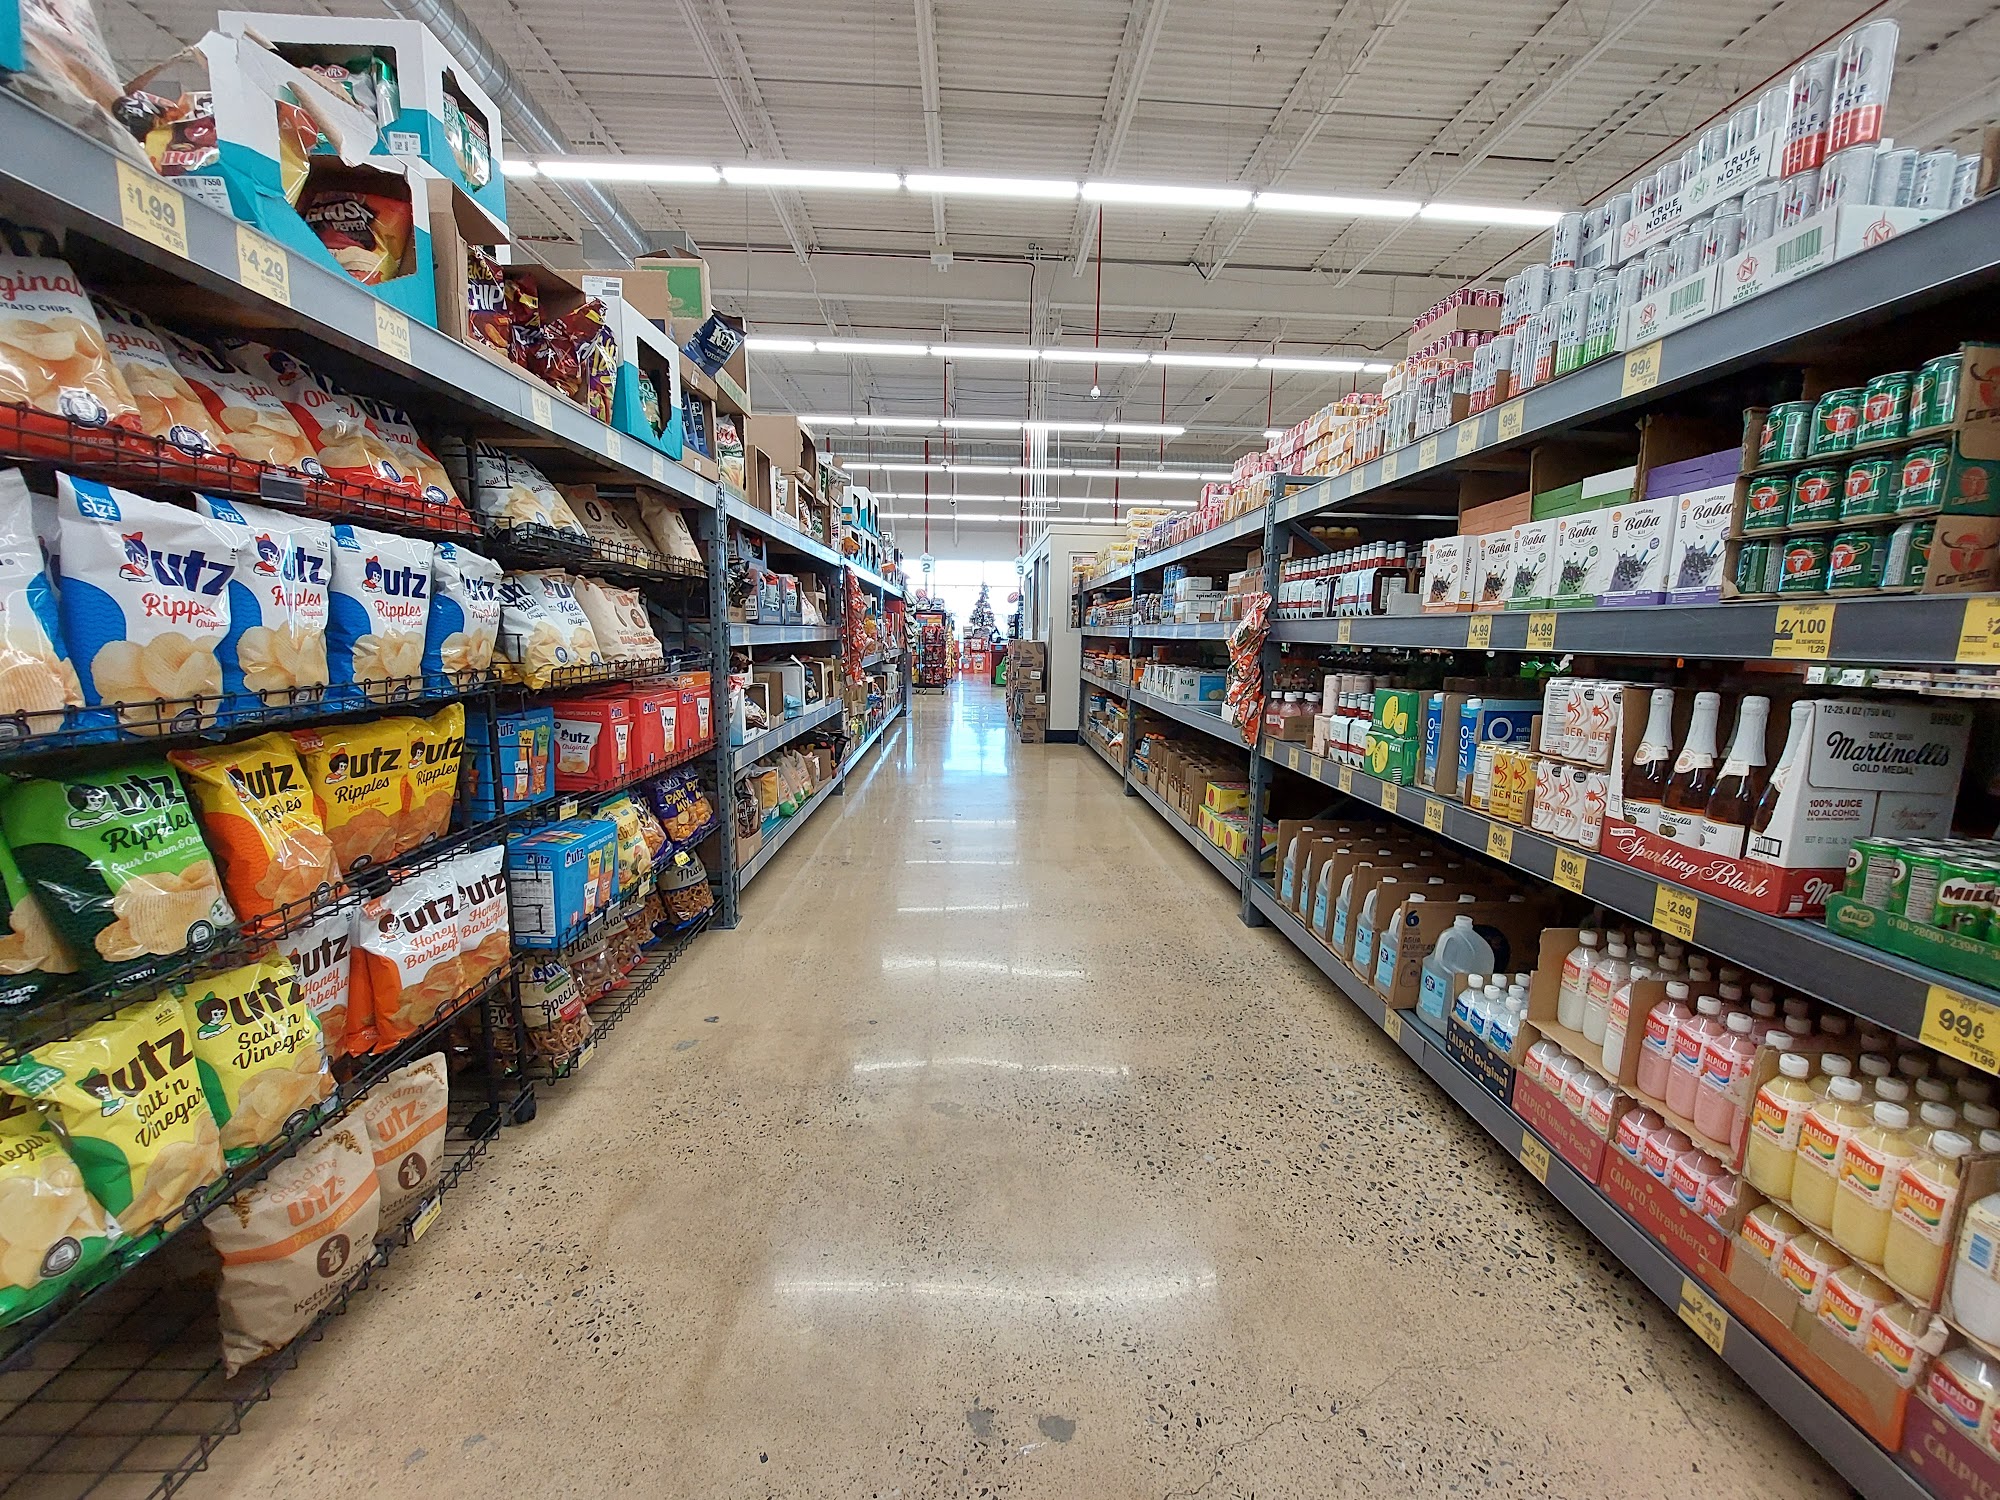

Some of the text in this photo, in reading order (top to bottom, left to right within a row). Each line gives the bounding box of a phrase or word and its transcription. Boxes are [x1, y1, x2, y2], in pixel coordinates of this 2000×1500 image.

[1716, 153, 1761, 185] NORTH
[1724, 145, 1758, 170] TRUE
[127, 183, 176, 228] $1.99
[306, 202, 374, 223] GHOST
[1651, 197, 1679, 218] TRUE
[333, 221, 367, 232] PEPPER
[1645, 205, 1683, 230] NORTH
[241, 245, 285, 284] $4.29
[468, 261, 493, 281] akis
[0, 269, 84, 301] ginal
[1732, 284, 1763, 302] NORTH
[39, 304, 73, 314] CHIPS
[378, 315, 408, 343] 2/3.00
[1629, 356, 1651, 378] 99¢
[1502, 412, 1517, 428] 99¢
[83, 502, 119, 518] SIZE
[1704, 495, 1726, 504] Instant
[1792, 496, 1836, 515] Carabao
[1624, 514, 1661, 531] Boba
[1692, 502, 1733, 521] Boba
[1521, 534, 1547, 547] Boba
[1567, 525, 1598, 540] Boba
[443, 550, 457, 560] SIZ
[1435, 547, 1458, 559] Boba
[1487, 543, 1511, 555] Boba
[374, 599, 422, 622] Ripples
[1530, 623, 1553, 637] $4.99
[1780, 618, 1826, 634] 2/1.00
[1823, 704, 1862, 716] 12-25.4 OZ
[561, 743, 589, 751] Original
[1426, 717, 1436, 756] ZICO
[1459, 725, 1469, 767] ZICO
[1868, 731, 1894, 740] SINCE
[1826, 730, 1950, 767] Martinelli's
[416, 762, 458, 786] Ripples
[1852, 763, 1914, 775] GOLD MEDAL
[334, 776, 390, 804] Ripples
[422, 779, 450, 794] Barbeque
[347, 796, 381, 813] Barbeque
[1807, 809, 1861, 817] NO ALCOHOL
[1809, 799, 1863, 808] 100% JUICE
[101, 812, 196, 853] Ripples
[1492, 831, 1507, 848] 99¢
[110, 839, 186, 874] Sour Cream &
[1560, 858, 1579, 878] 99¢
[1616, 834, 1700, 880] Sparkling
[1699, 859, 1769, 898] Blush
[468, 899, 502, 922] Honey
[1405, 909, 1420, 927] 6
[1666, 899, 1693, 920] $2.99
[1840, 909, 1871, 923] MILO
[410, 922, 457, 952] Honey
[1402, 943, 1435, 951] PURIFICAD
[1403, 936, 1422, 944] AGUA
[403, 937, 460, 970] Barbeq
[117, 967, 156, 984] OTATO
[302, 967, 340, 998] Honey
[305, 975, 350, 1010] rbeque
[541, 983, 576, 1017] Specia
[238, 1020, 281, 1050] Salt
[1938, 1008, 1986, 1043] 99¢
[232, 1026, 310, 1070] Vinega
[1448, 1030, 1508, 1090] CALPICO Original
[26, 1067, 64, 1094] SIZE
[136, 1090, 166, 1126] Salt
[364, 1084, 424, 1123] Grandma
[135, 1085, 206, 1148] Vinegar
[1517, 1087, 1594, 1161] CALPICO White Peach
[1758, 1124, 1780, 1141] MANGO
[0, 1133, 51, 1165] negar
[1805, 1148, 1829, 1167] MANGO
[269, 1157, 339, 1205] Grandma
[1847, 1178, 1873, 1199] MANGO
[1609, 1165, 1711, 1260] CALPICO Strawberry
[1704, 1191, 1727, 1216] CALPIC
[294, 1215, 333, 1246] Party
[1903, 1211, 1933, 1234] MANGO
[293, 1254, 368, 1315] Kettle-Styl
[1871, 1326, 1908, 1358] CALPICO
[1932, 1374, 1978, 1412] CALPICO
